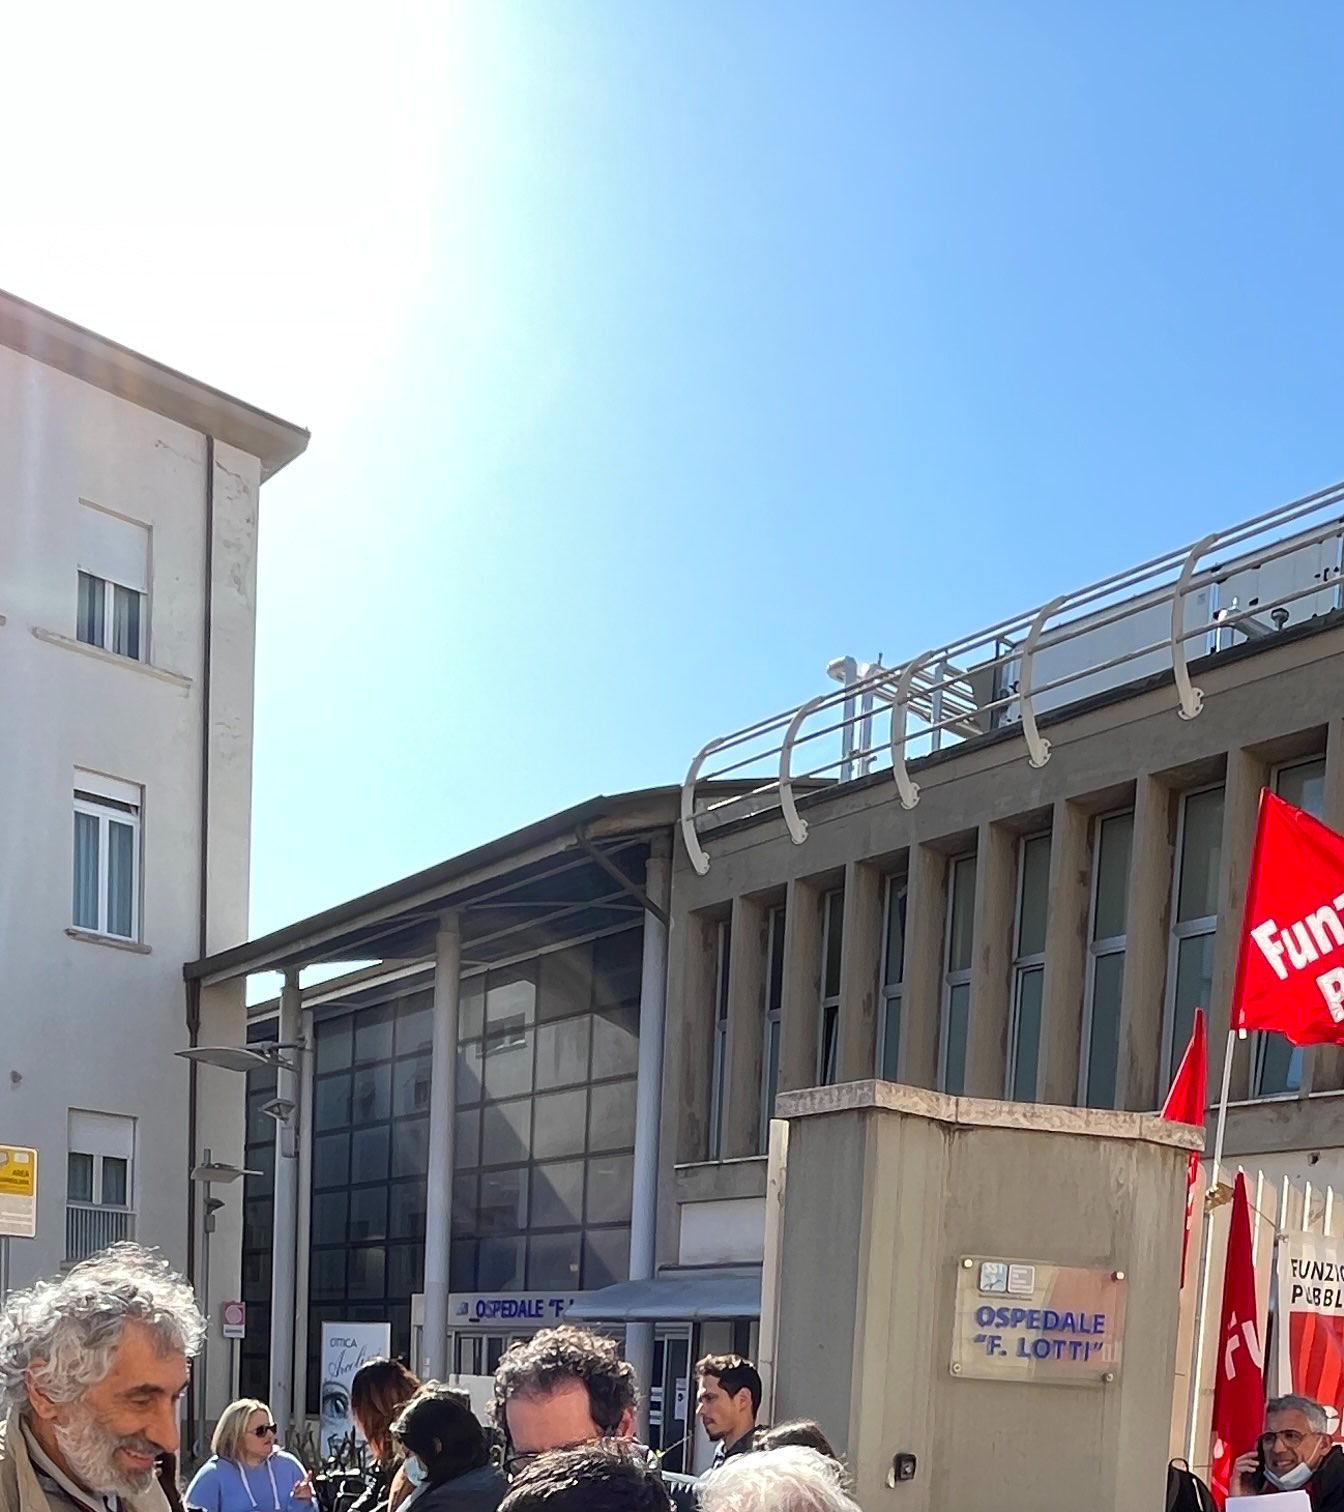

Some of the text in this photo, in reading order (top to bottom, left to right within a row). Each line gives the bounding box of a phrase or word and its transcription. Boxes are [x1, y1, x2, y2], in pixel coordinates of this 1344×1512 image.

[475, 1299, 544, 1319] OSPEDALE
[975, 1305, 1106, 1335] OSPEDALE
[329, 1337, 358, 1348] OTTICA
